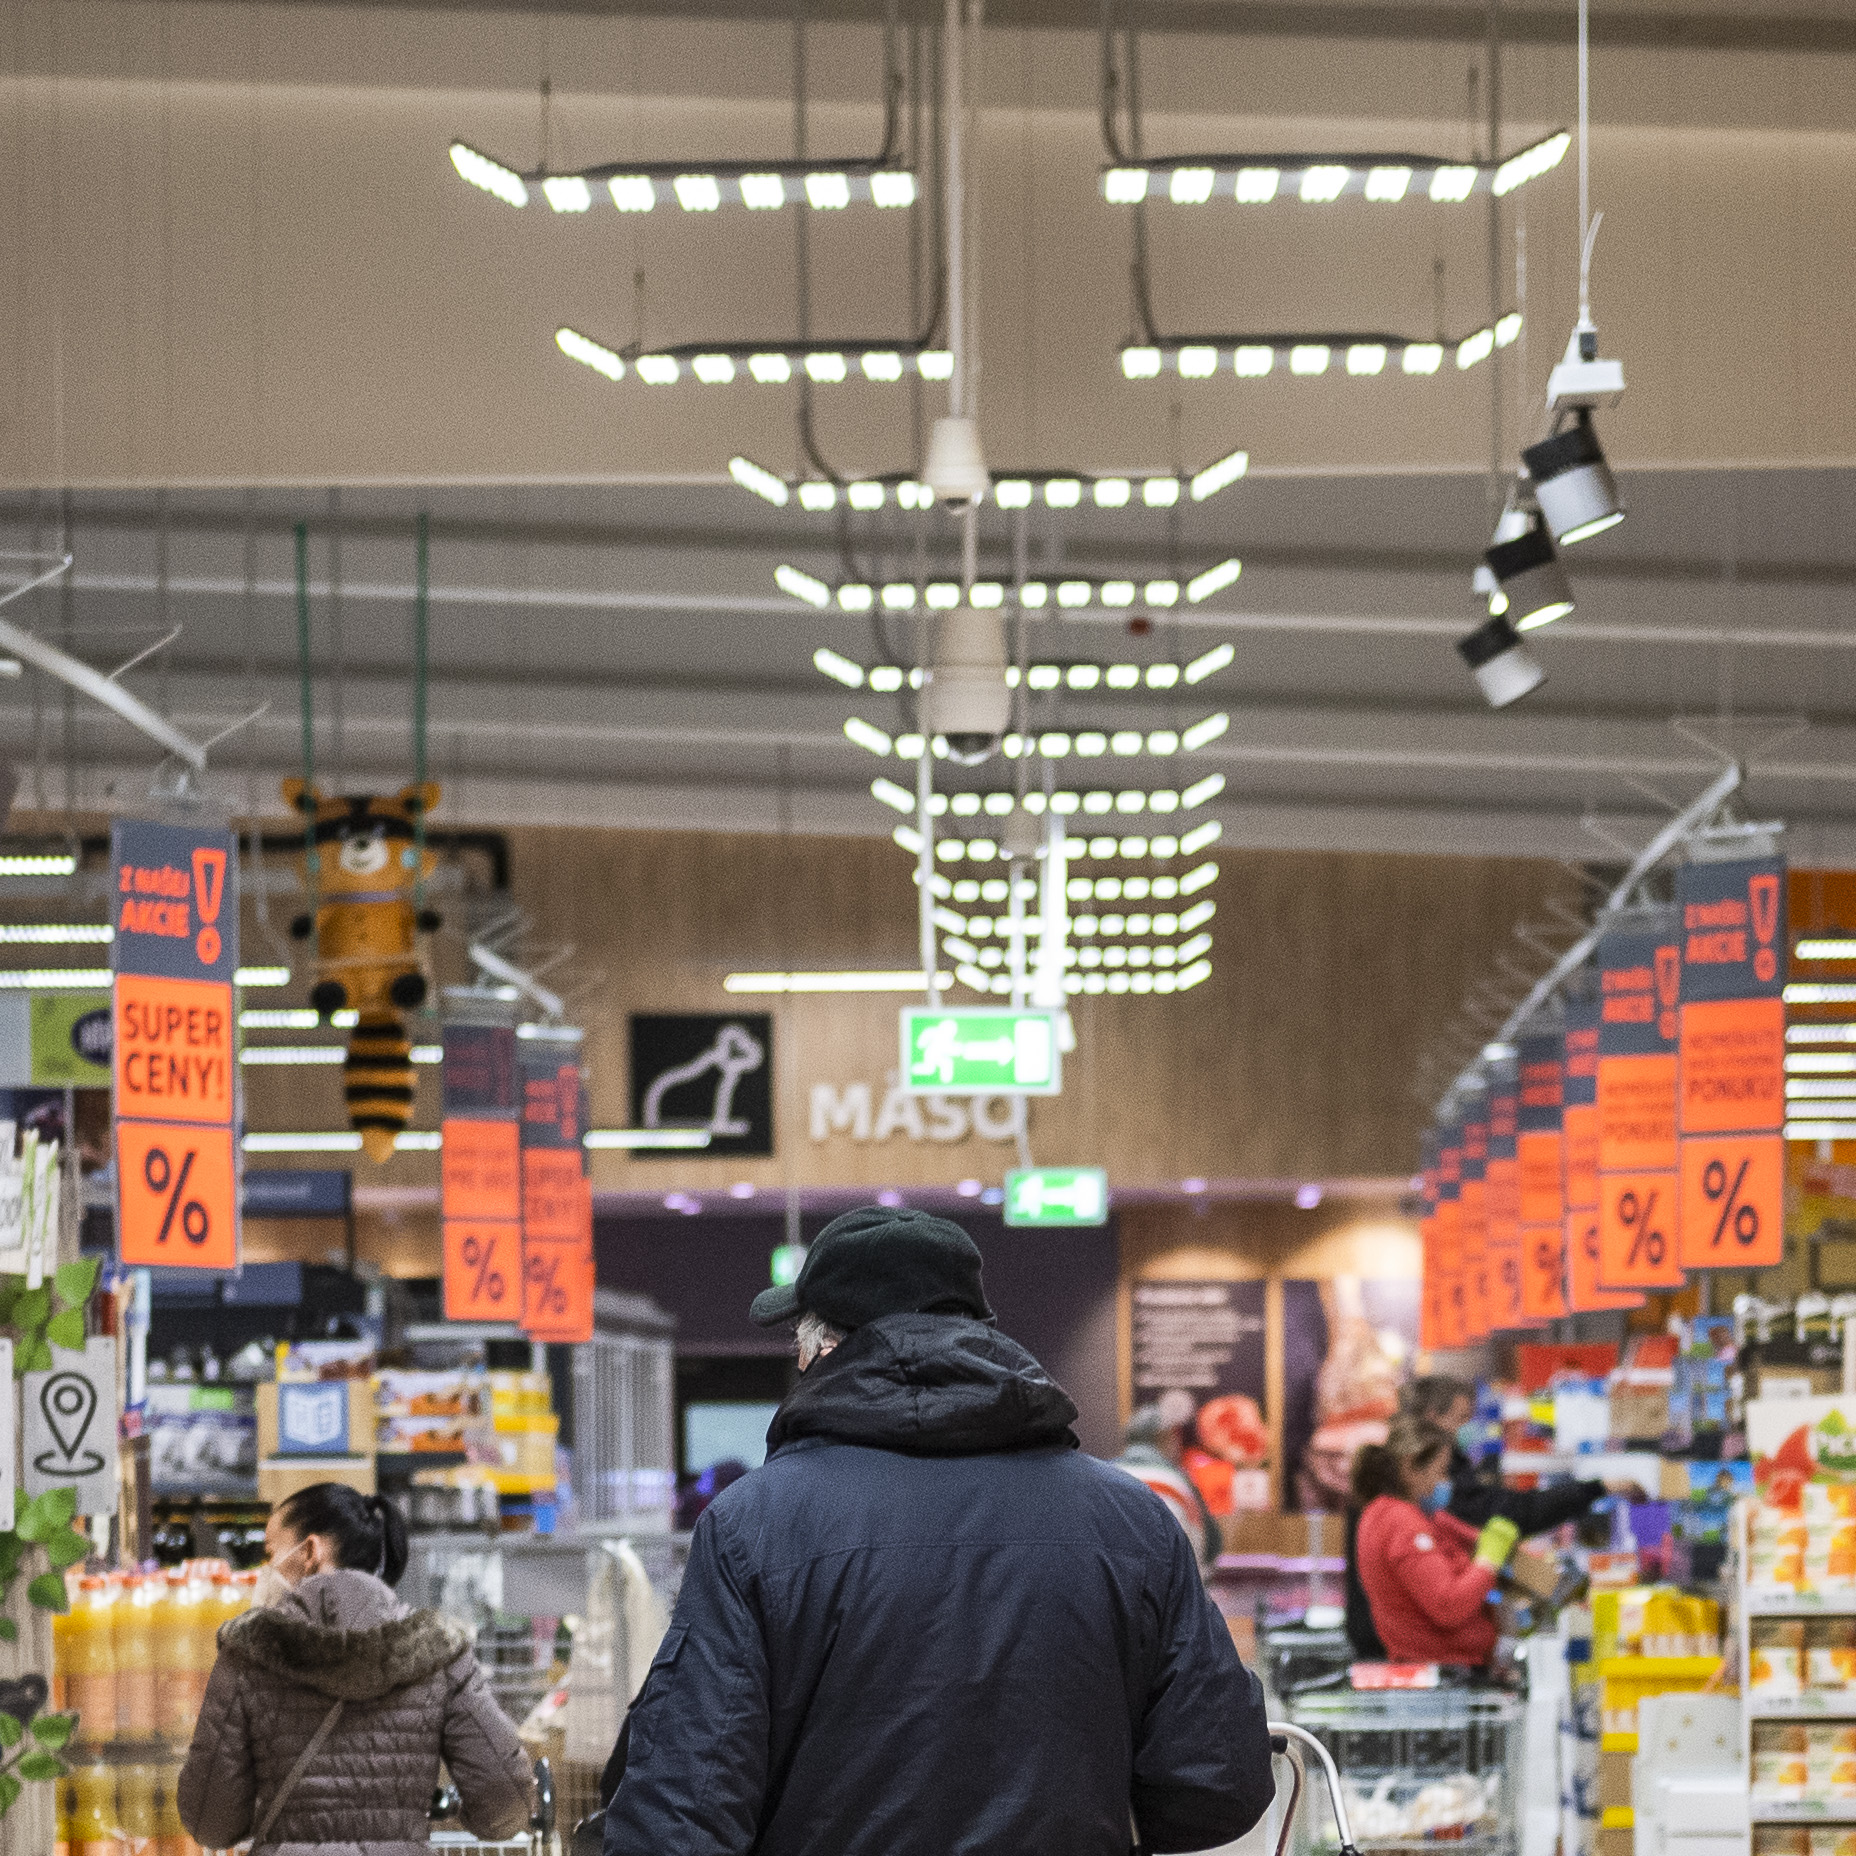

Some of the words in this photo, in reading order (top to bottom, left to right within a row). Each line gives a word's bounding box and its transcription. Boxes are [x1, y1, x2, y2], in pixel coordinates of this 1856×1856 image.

[124, 1003, 223, 1049] SUPER
[125, 1051, 225, 1101] CENY!
[144, 1147, 211, 1246] %
